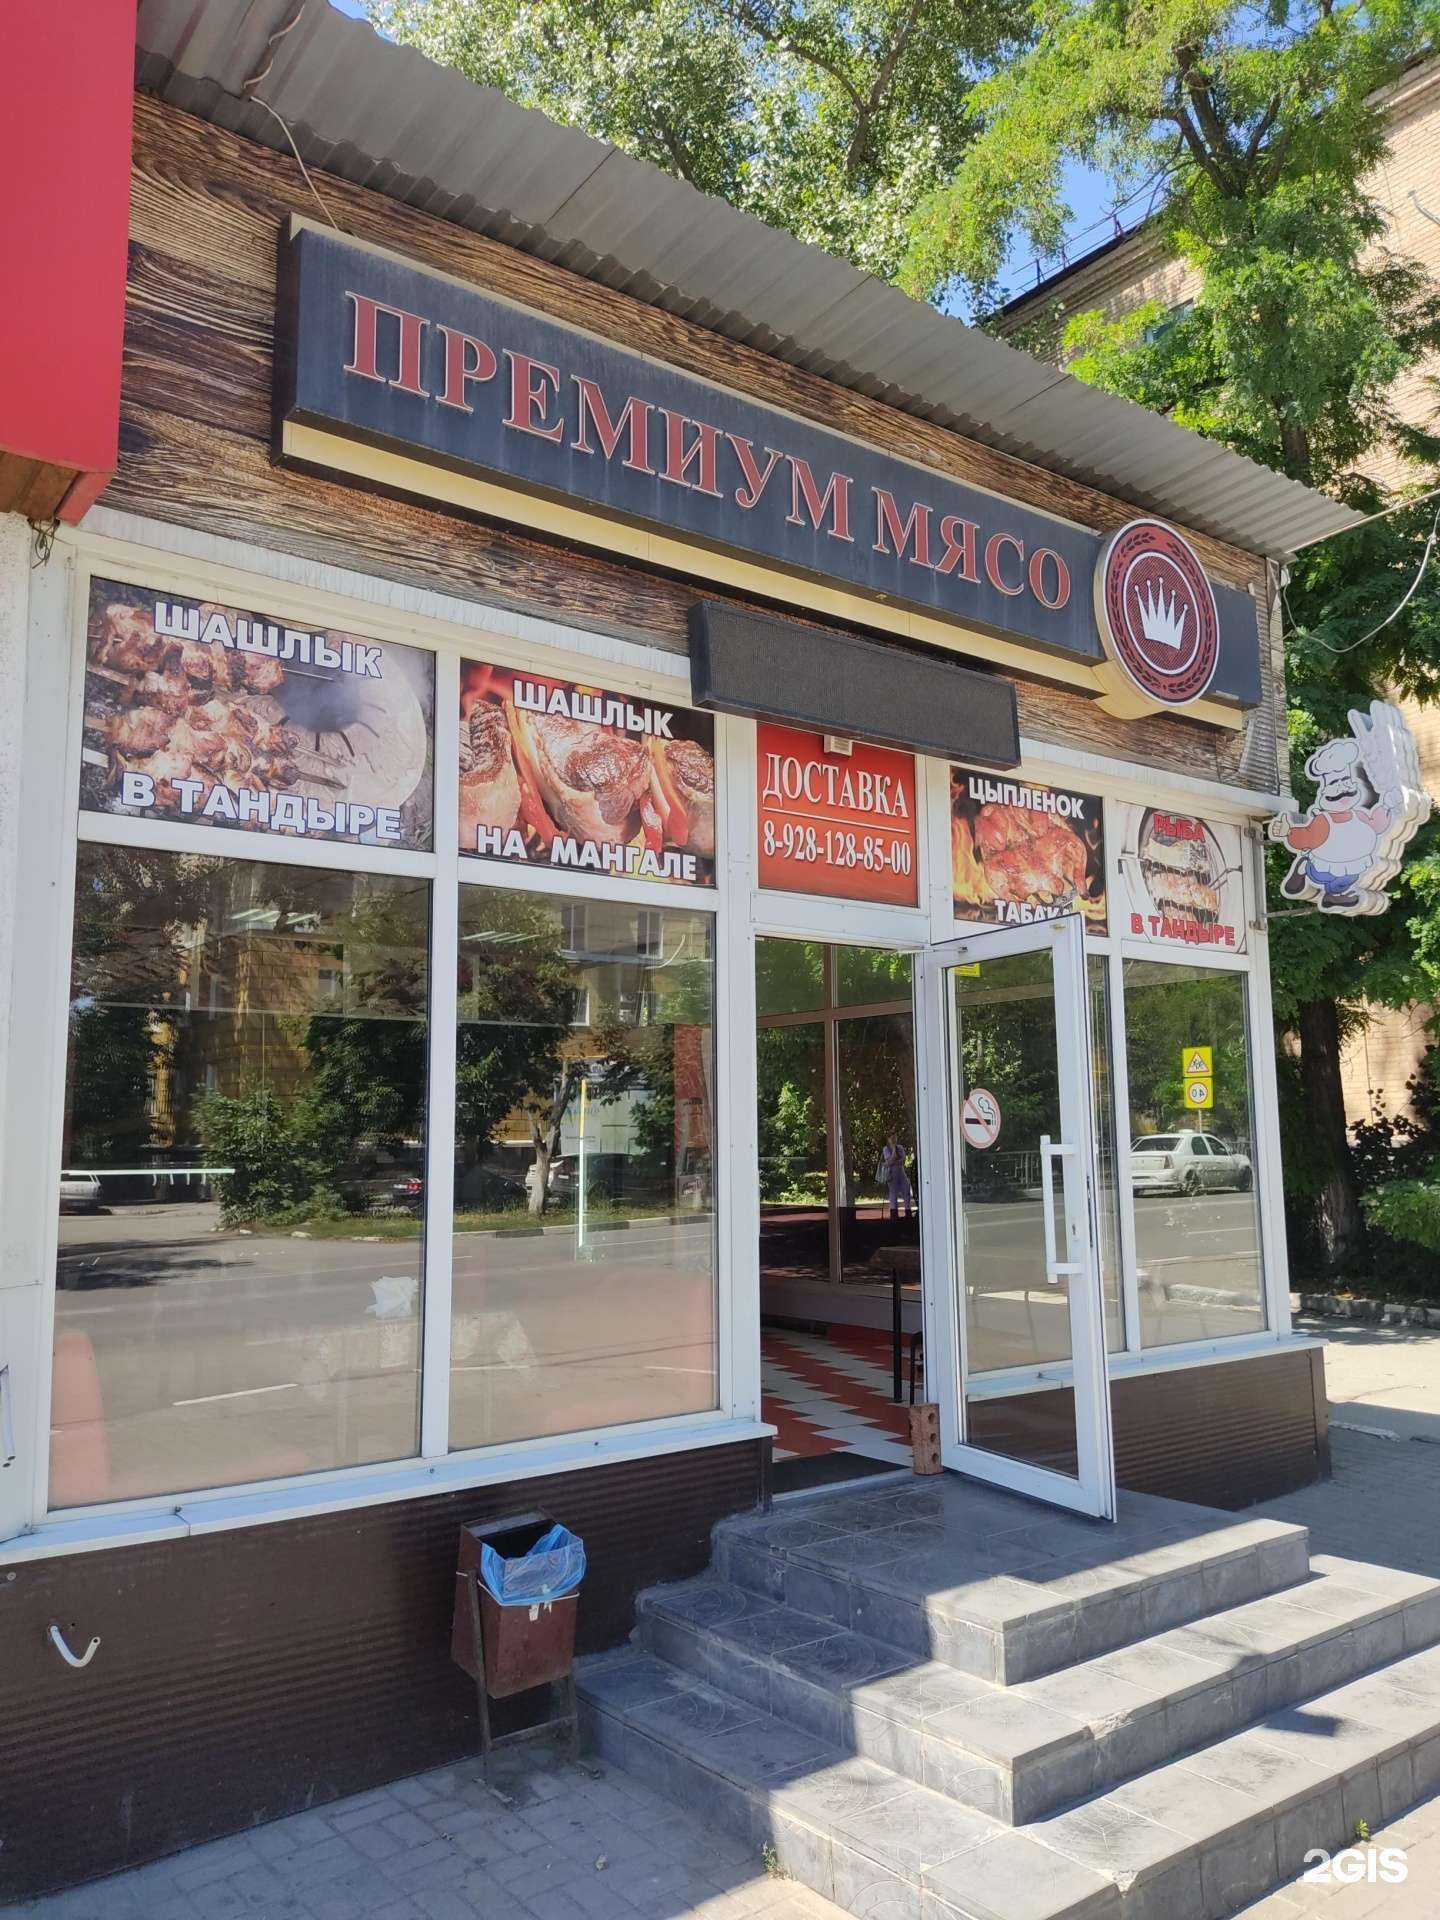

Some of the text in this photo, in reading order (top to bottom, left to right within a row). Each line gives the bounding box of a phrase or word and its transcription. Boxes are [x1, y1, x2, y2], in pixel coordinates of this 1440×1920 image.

[343, 290, 1071, 610] ПРЕМИУМ МЯСО
[153, 601, 383, 679] ШАШЛЫК
[512, 679, 674, 739] ШАШЛЫК
[121, 771, 402, 840] В ТАНДЫРЕ
[762, 752, 909, 819] ДОСТАВКА
[968, 776, 1086, 820] ЦЫПЛЕНОК
[476, 823, 698, 882] НА МАНГАЛЕ
[762, 820, 911, 877] 8-928-128-85-00
[1153, 813, 1206, 843] РЫБА
[994, 898, 1071, 924] ТАБАК
[1130, 912, 1236, 946] В ТАНДЫРЕ
